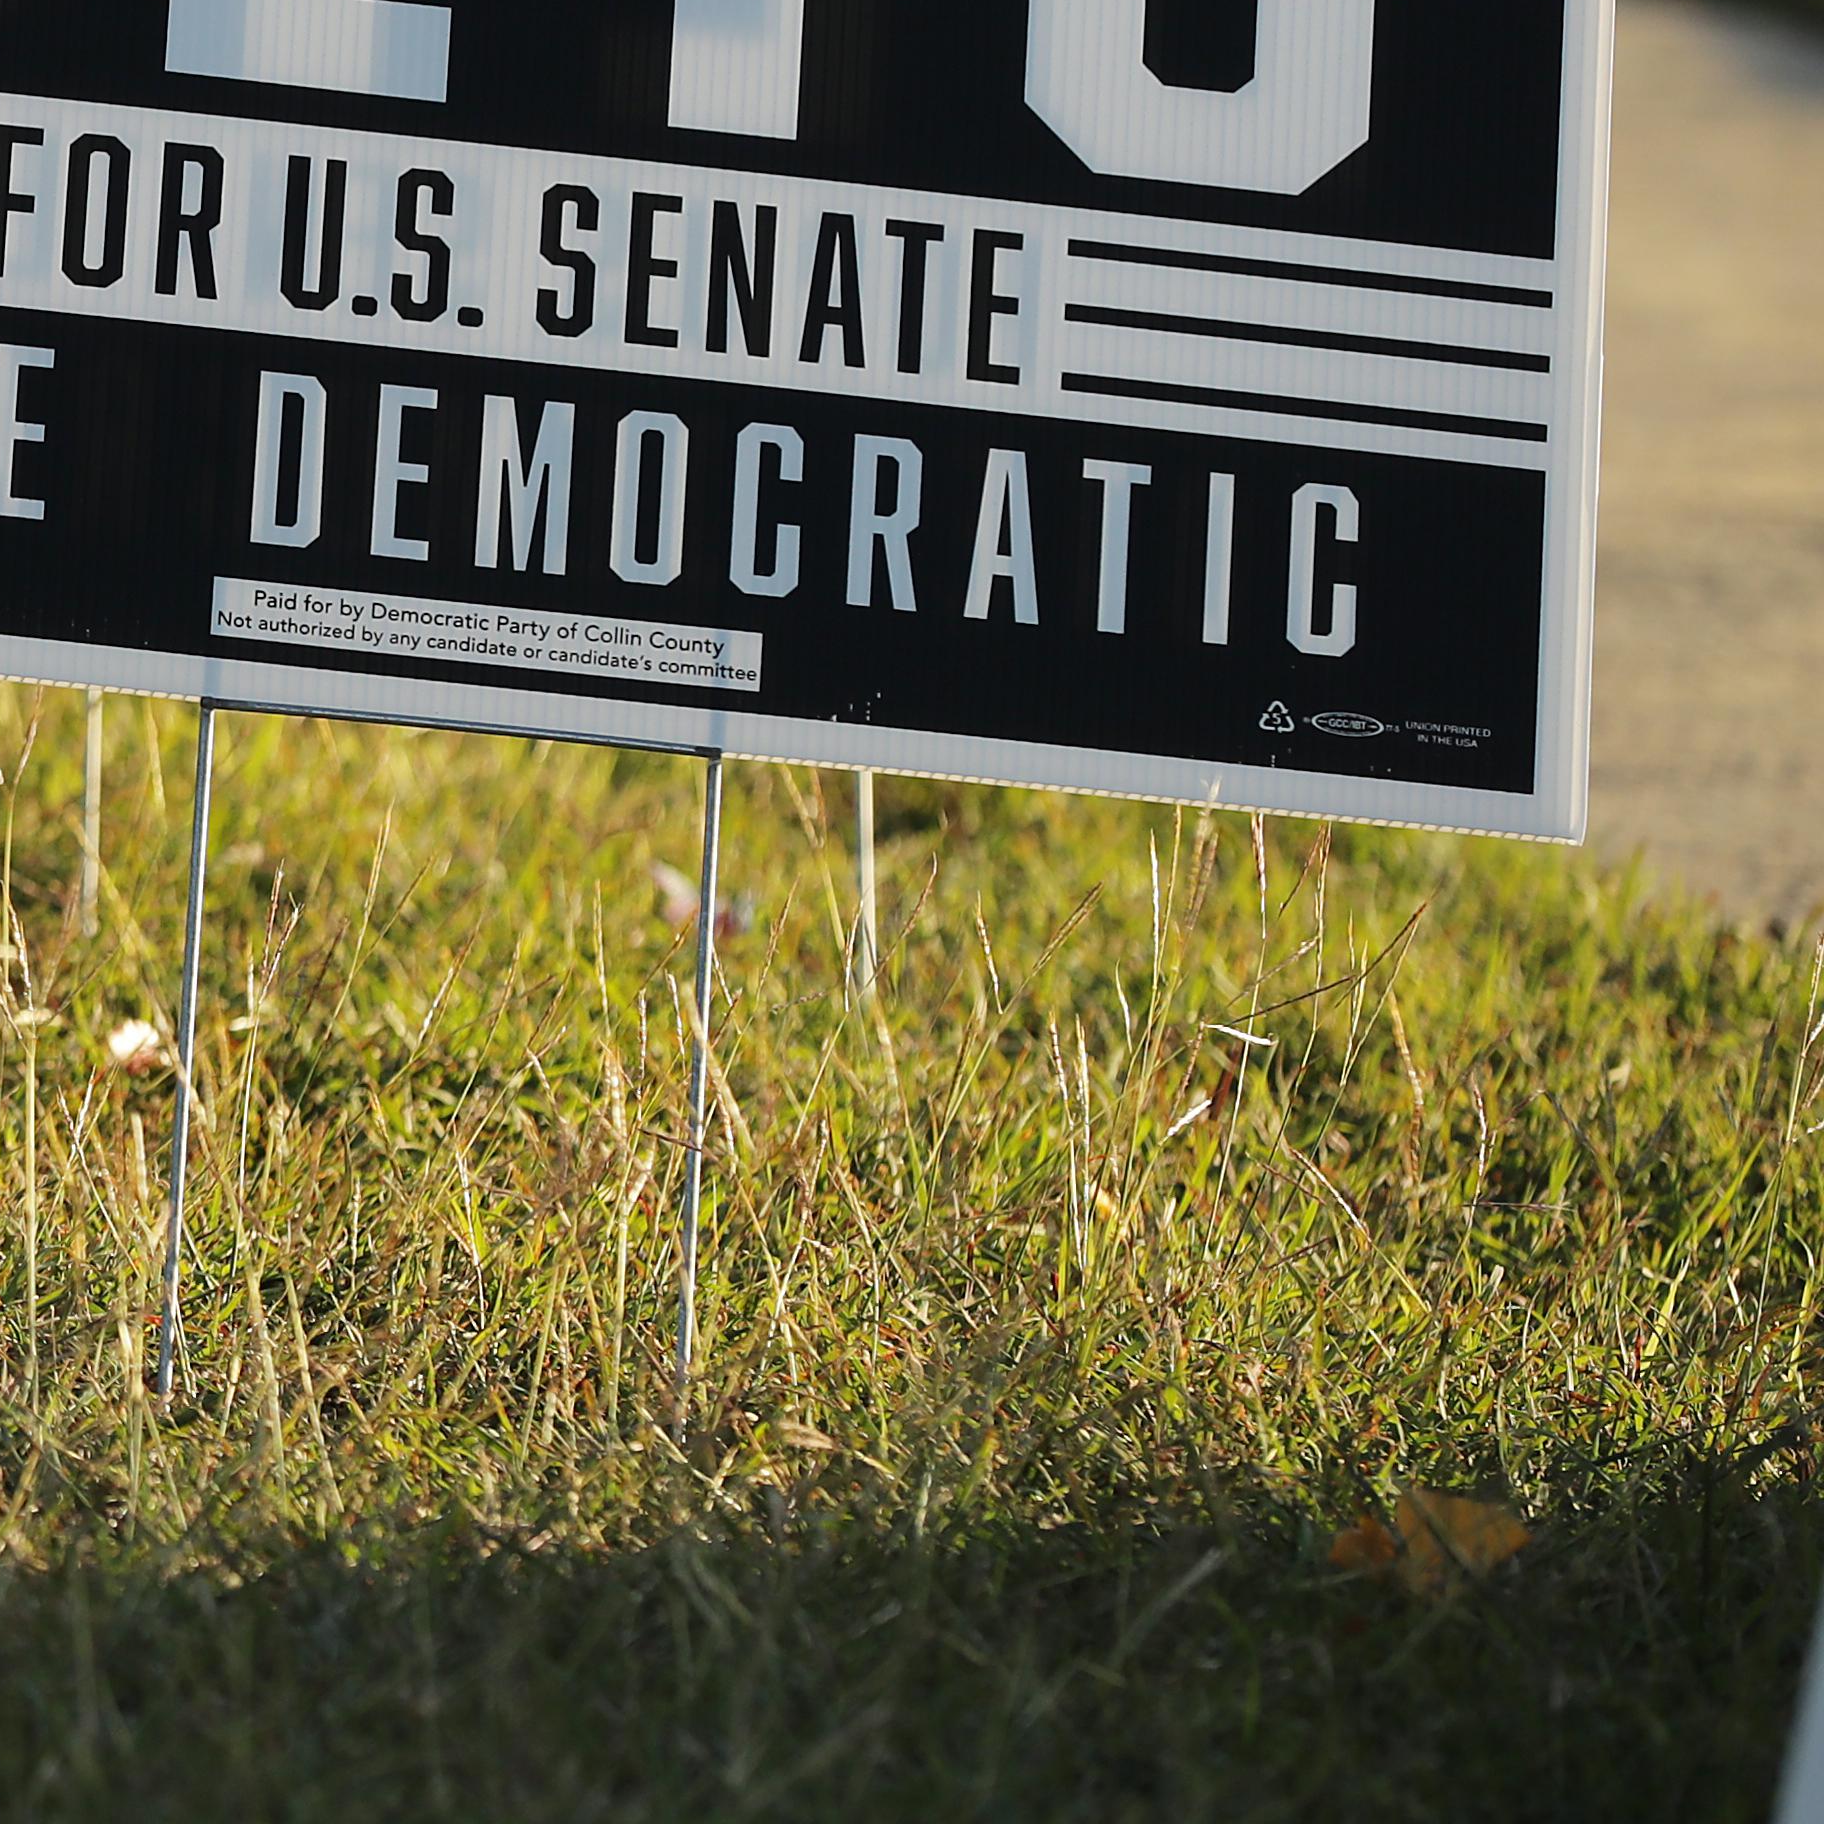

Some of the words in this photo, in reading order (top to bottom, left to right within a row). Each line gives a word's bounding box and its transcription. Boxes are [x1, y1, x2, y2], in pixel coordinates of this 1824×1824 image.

[278, 154, 484, 328] U.S.
[535, 182, 1023, 385] SENATE
[250, 370, 1359, 657] DEMOCRATIC
[217, 610, 252, 629] Not
[258, 616, 355, 641] authorized
[362, 625, 384, 646] by
[389, 632, 421, 650] any
[426, 636, 517, 657] candidate
[523, 646, 542, 659] or
[548, 649, 652, 670] candidate's
[658, 661, 757, 681] committee
[254, 589, 297, 610] Paid
[304, 594, 333, 613] for
[340, 598, 365, 622] by
[371, 602, 490, 631] Democratic
[496, 615, 551, 641] Party
[557, 622, 579, 639] of
[584, 623, 642, 646] Collin
[649, 631, 725, 659] County
[1405, 720, 1441, 732] UNION
[1444, 724, 1491, 738] PRINTED
[1432, 735, 1452, 745] THE
[1455, 738, 1479, 748] USA
